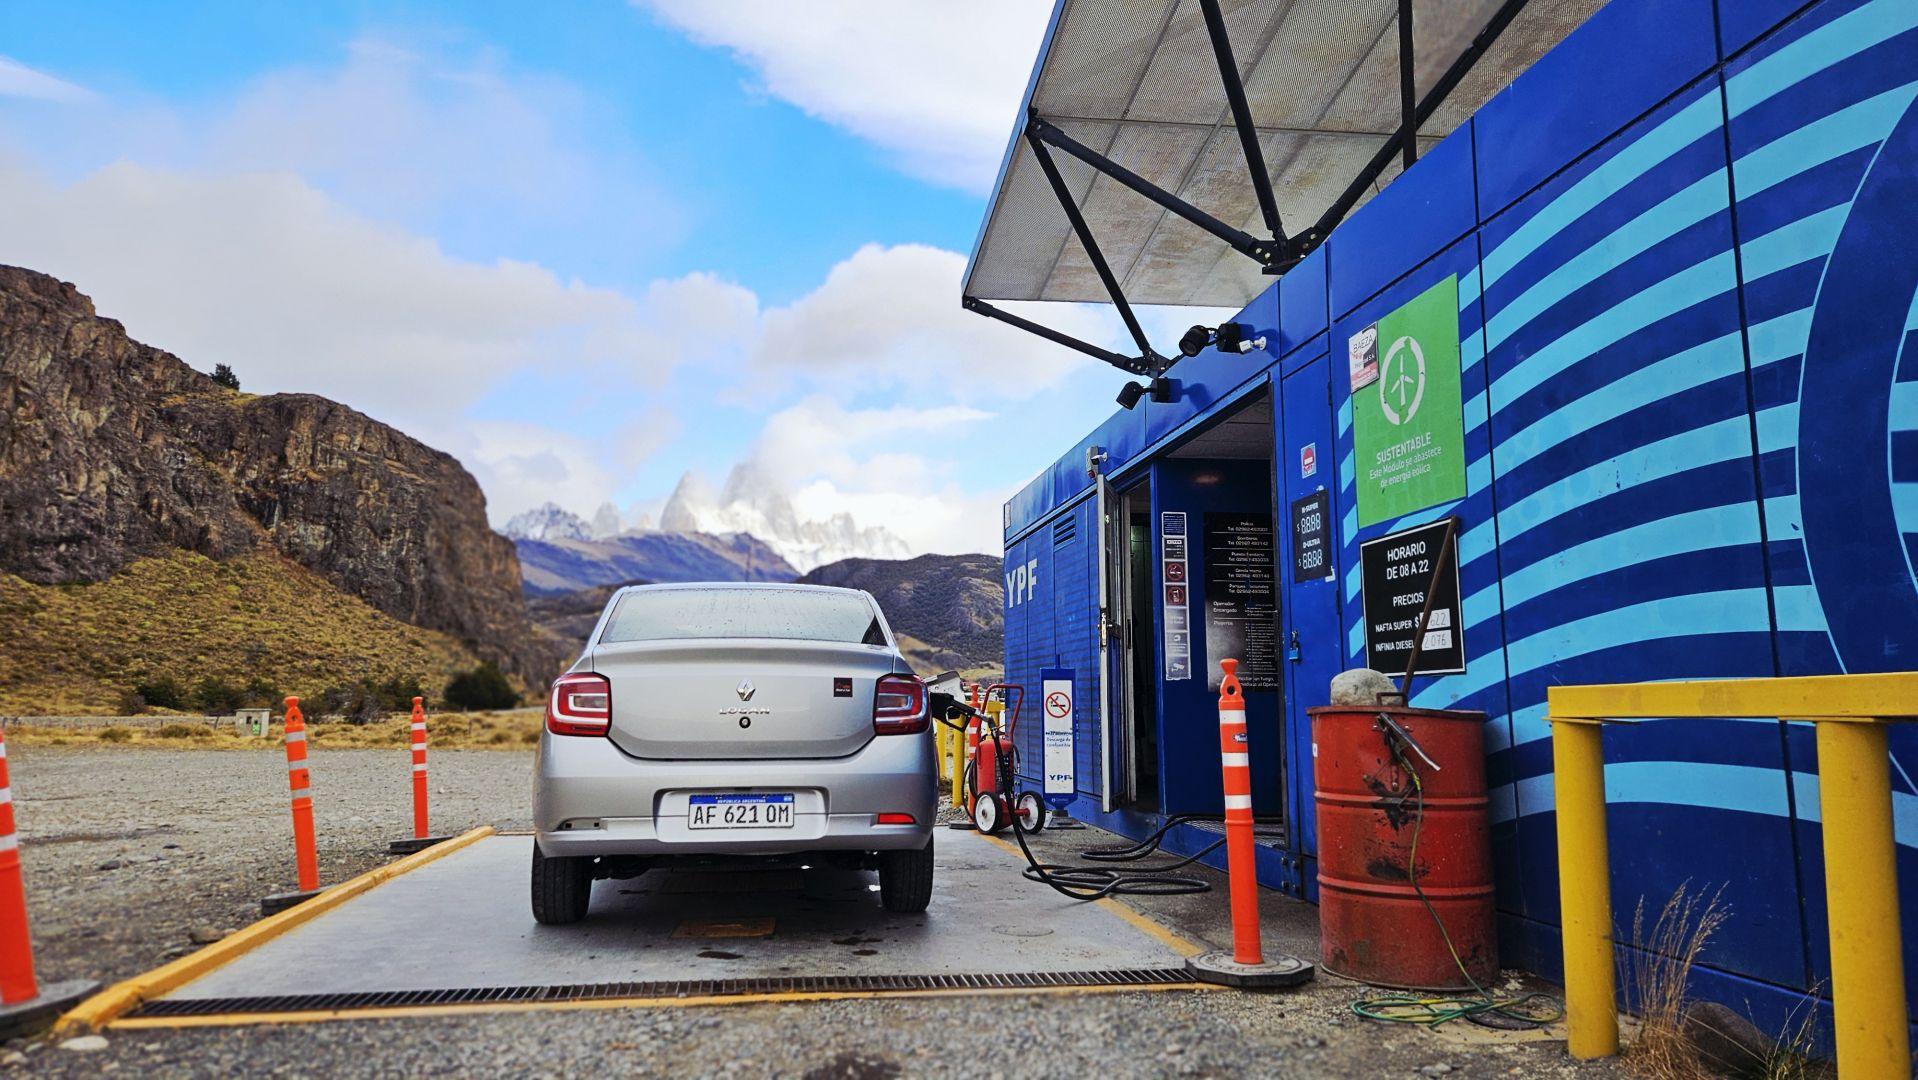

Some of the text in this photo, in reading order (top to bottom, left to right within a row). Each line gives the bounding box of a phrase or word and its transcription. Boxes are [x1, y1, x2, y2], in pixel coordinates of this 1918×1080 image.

[1376, 432, 1432, 465] SUSTENTABLE
[1369, 469, 1382, 480] Este
[1387, 541, 1426, 562] HORARIO
[1386, 559, 1429, 580] DE 08 A 22
[1005, 558, 1038, 609] YPF
[1392, 592, 1424, 607] PRECIOS
[1375, 622, 1393, 633] NAFTA
[1393, 619, 1412, 631] SUPER
[1415, 615, 1420, 629] $
[1375, 639, 1415, 651] INFINIA DIESEL
[719, 705, 770, 715] LOGAN
[694, 805, 718, 825] AF
[724, 804, 759, 824] 621
